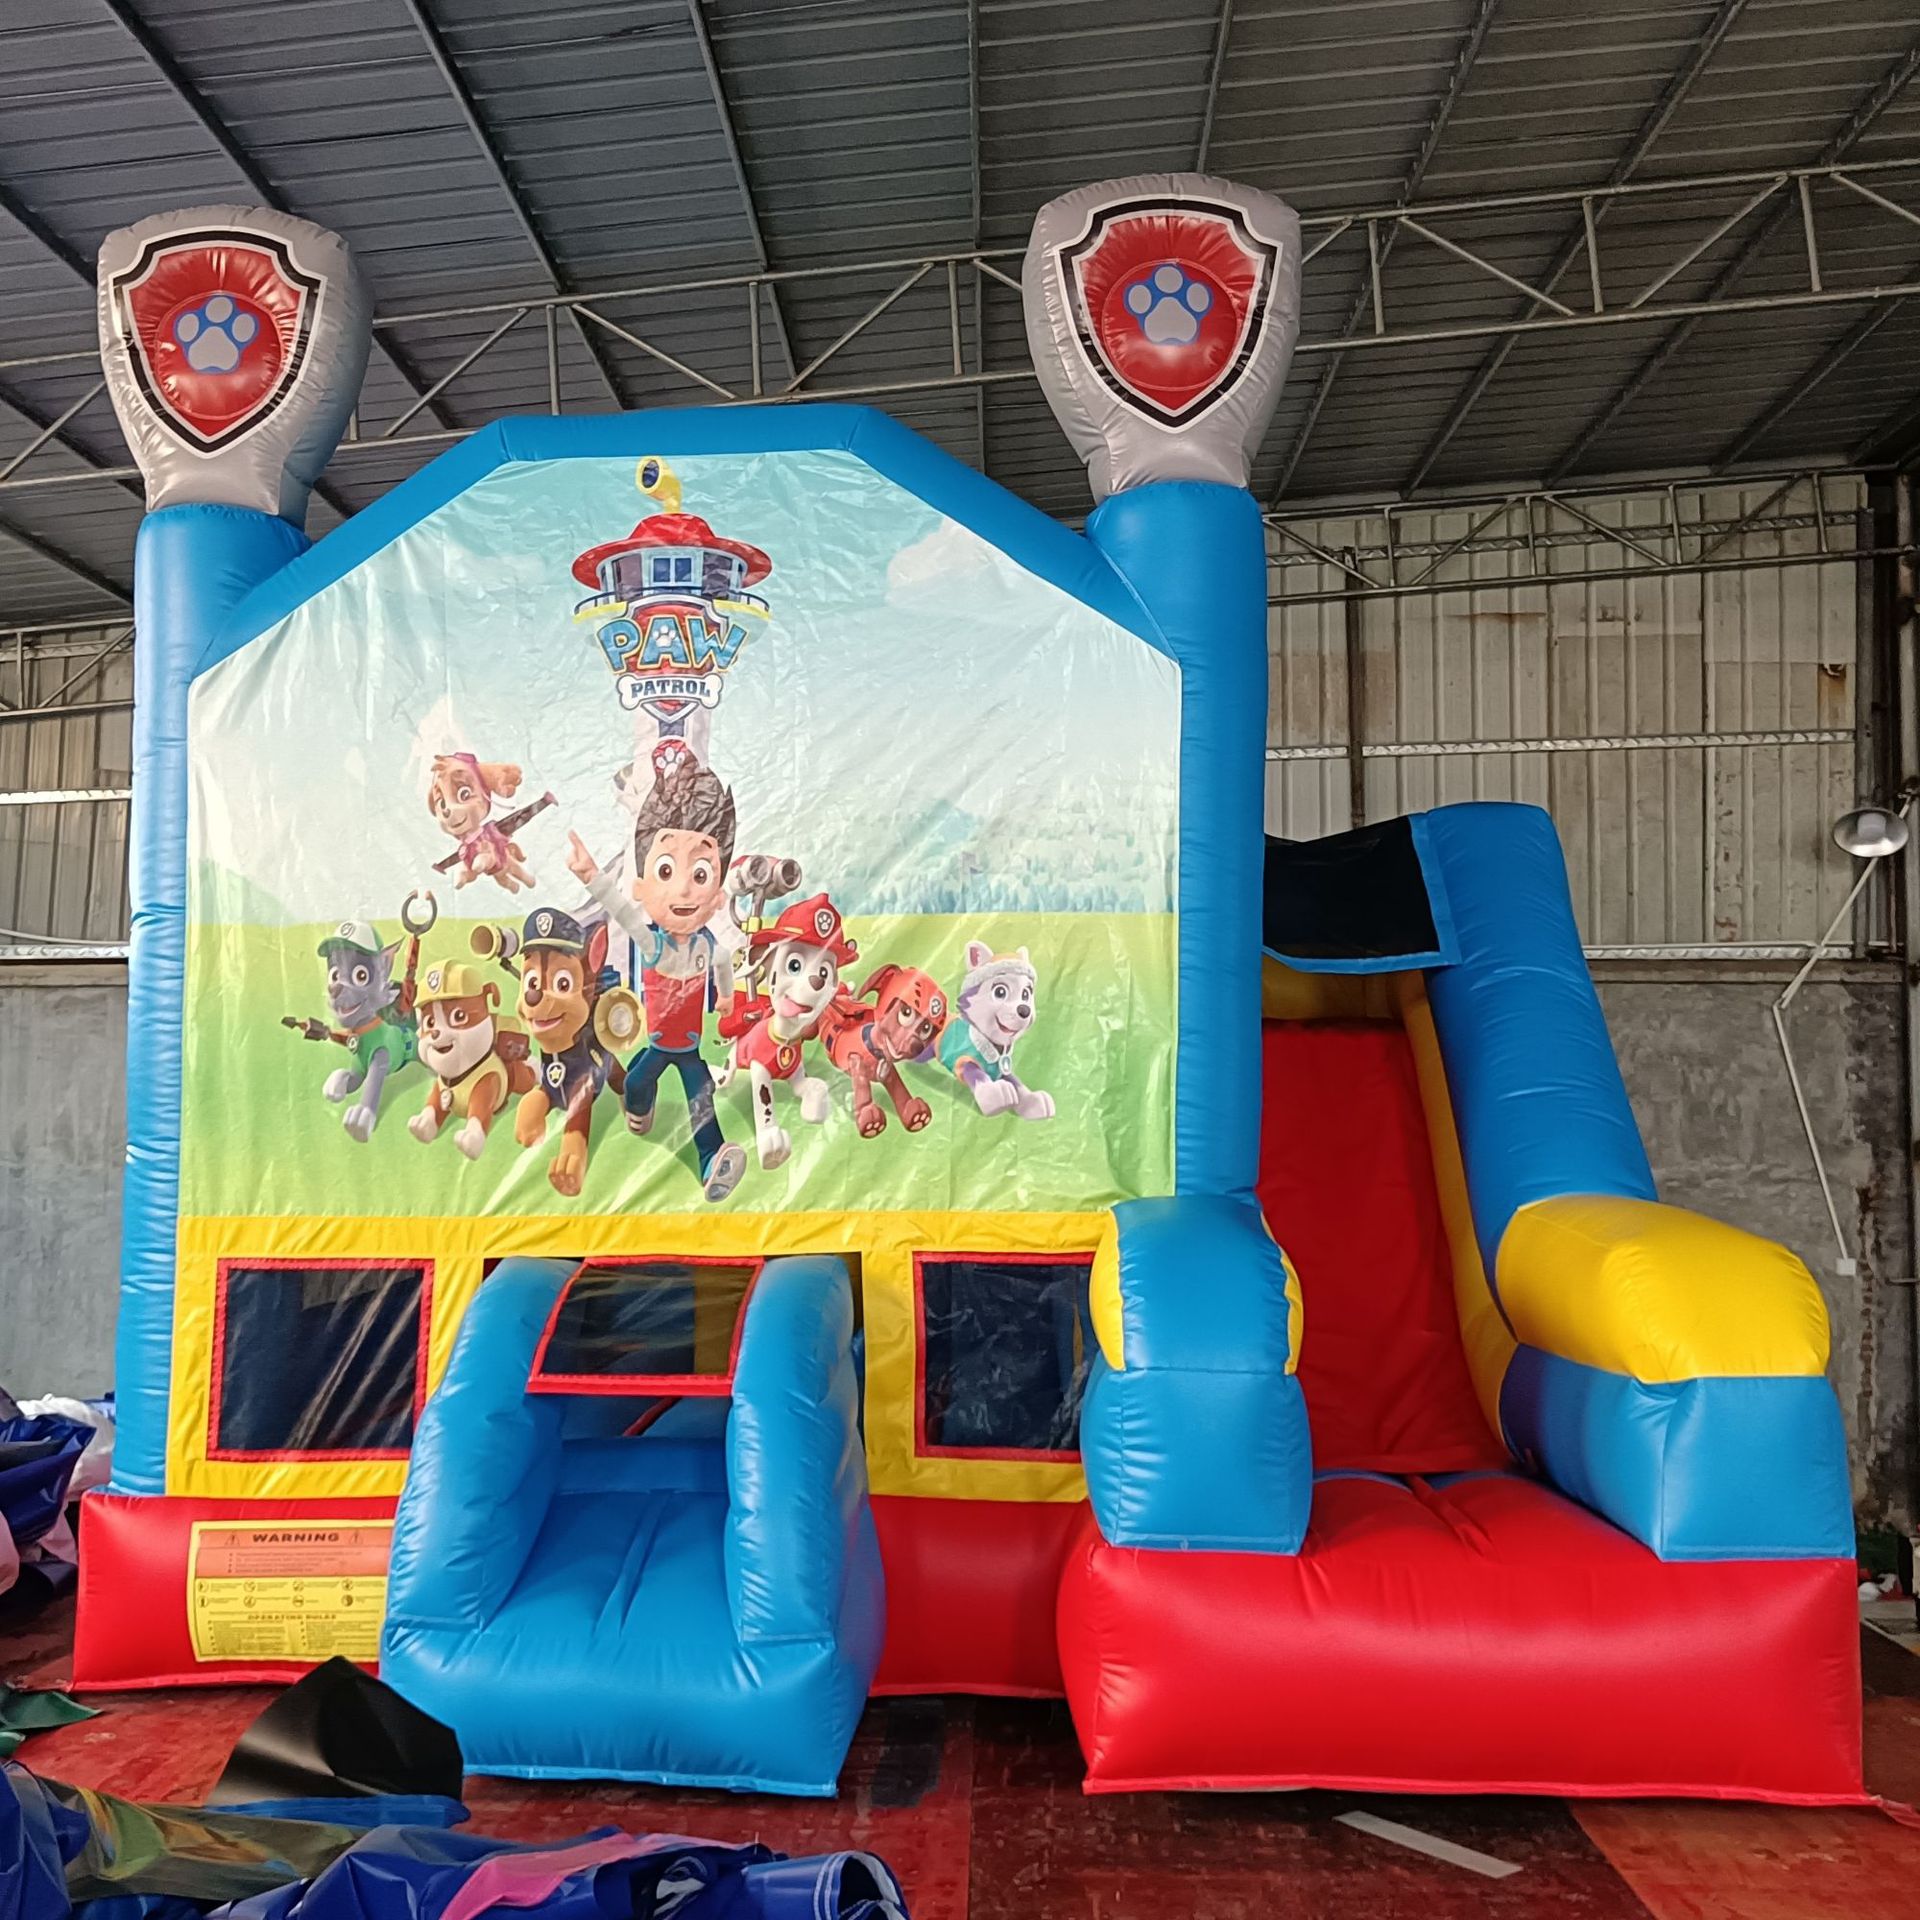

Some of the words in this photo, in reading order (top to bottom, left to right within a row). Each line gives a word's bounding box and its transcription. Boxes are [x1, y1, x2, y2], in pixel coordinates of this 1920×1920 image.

[597, 614, 748, 674] PAW
[631, 679, 711, 698] PATROL
[252, 1532, 340, 1543] WARNING
